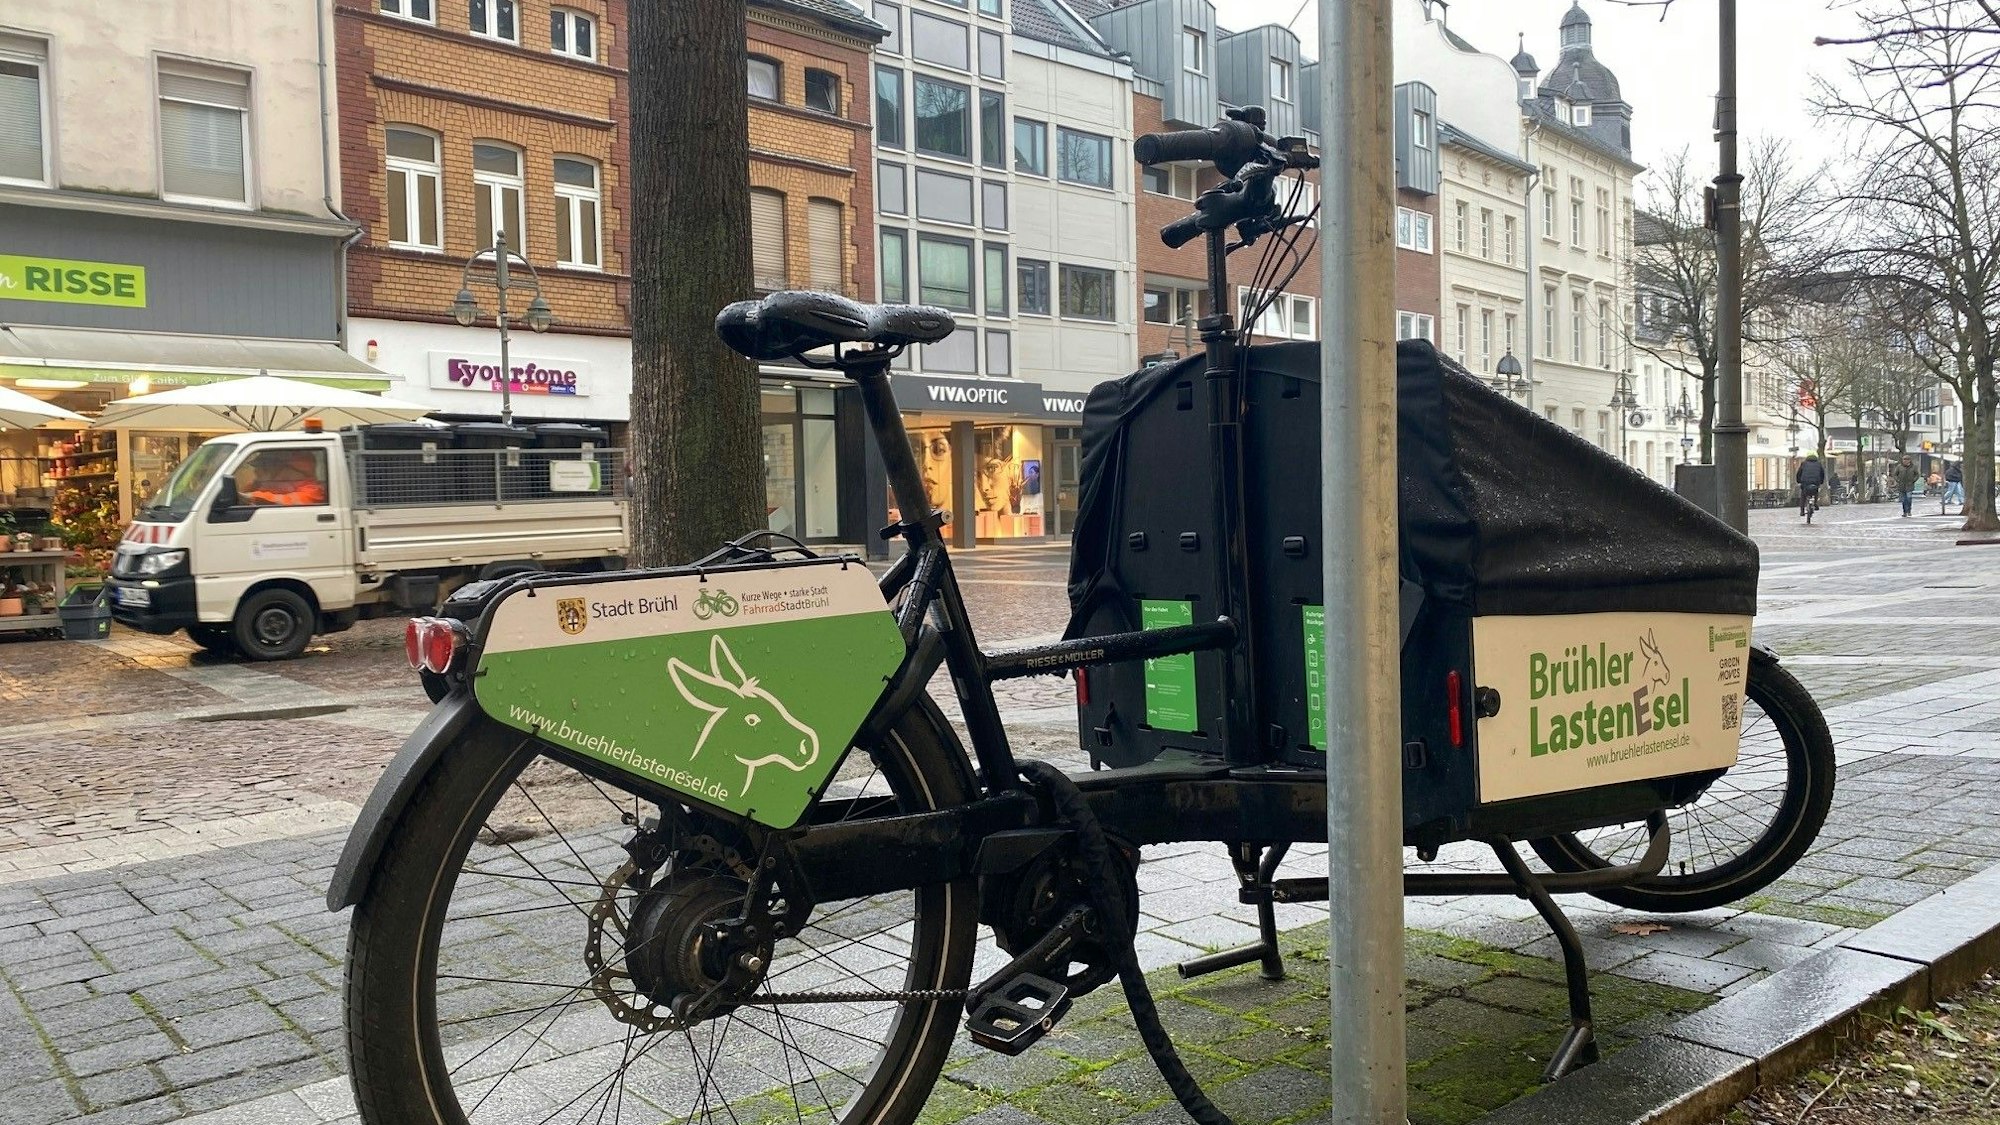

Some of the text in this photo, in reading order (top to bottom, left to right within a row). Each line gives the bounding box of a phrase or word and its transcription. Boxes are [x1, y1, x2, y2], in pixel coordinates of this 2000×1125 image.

[24, 265, 136, 298] RISSE
[1042, 397, 1087, 413] VIVAO
[591, 594, 678, 619] Stadt Brühl
[741, 584, 829, 602] Kurze Wege starke Stadt
[743, 596, 830, 616] FahrradStadtBrühl
[1026, 655, 1058, 669] RIESE
[1529, 641, 1634, 700] Brühler
[1529, 677, 1690, 757] LastenEsel
[508, 703, 729, 803] www.bruehlerlastenesel.de
[1585, 733, 1691, 769] www.bruehlerlastenesel.de
